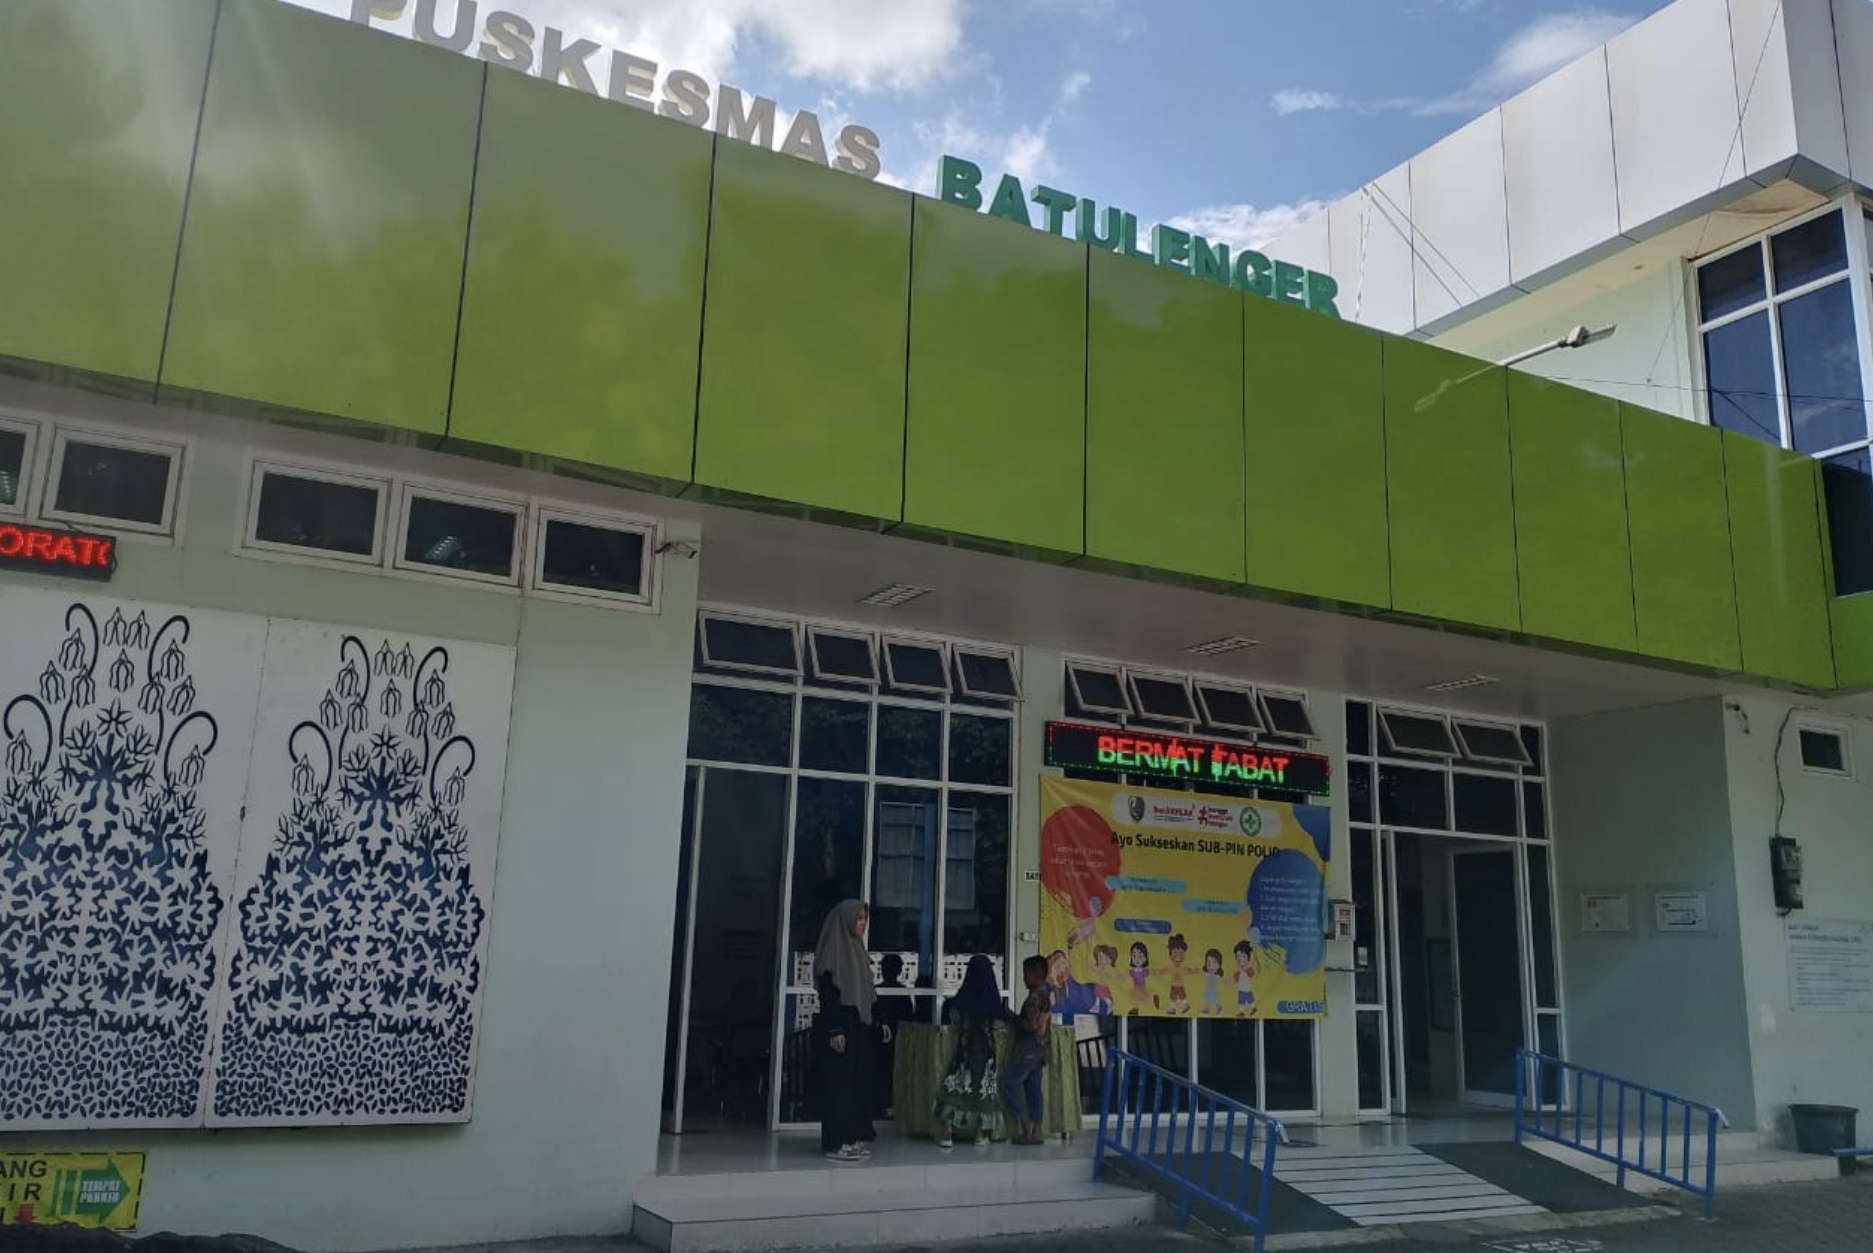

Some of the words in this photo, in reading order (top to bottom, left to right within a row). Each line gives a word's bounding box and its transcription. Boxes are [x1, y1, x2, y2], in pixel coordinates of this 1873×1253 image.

[935, 154, 1343, 320] BATULENGER
[1111, 832, 1133, 849] Ayo
[1136, 833, 1195, 852] Sukseskan
[1197, 839, 1246, 856] SUB-PIN
